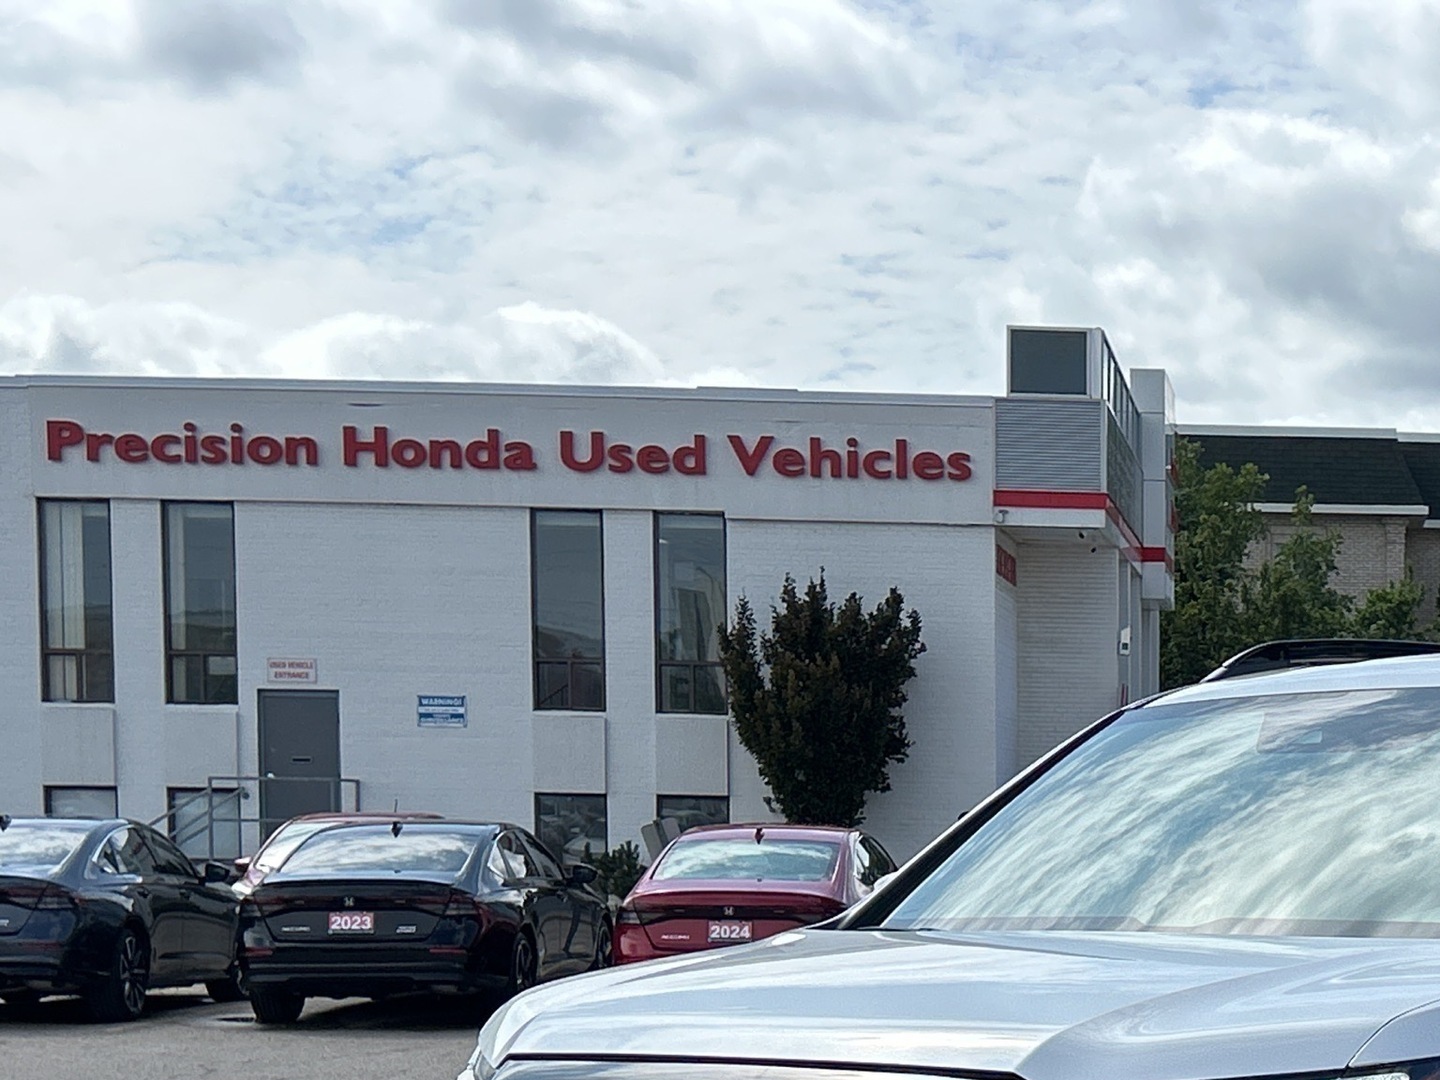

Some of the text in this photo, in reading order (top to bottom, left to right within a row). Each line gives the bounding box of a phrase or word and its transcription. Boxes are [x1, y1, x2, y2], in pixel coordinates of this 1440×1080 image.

[47, 420, 972, 482] Precision Honda Used Vehicles
[331, 915, 372, 930] 2023
[710, 925, 751, 939] 2024
